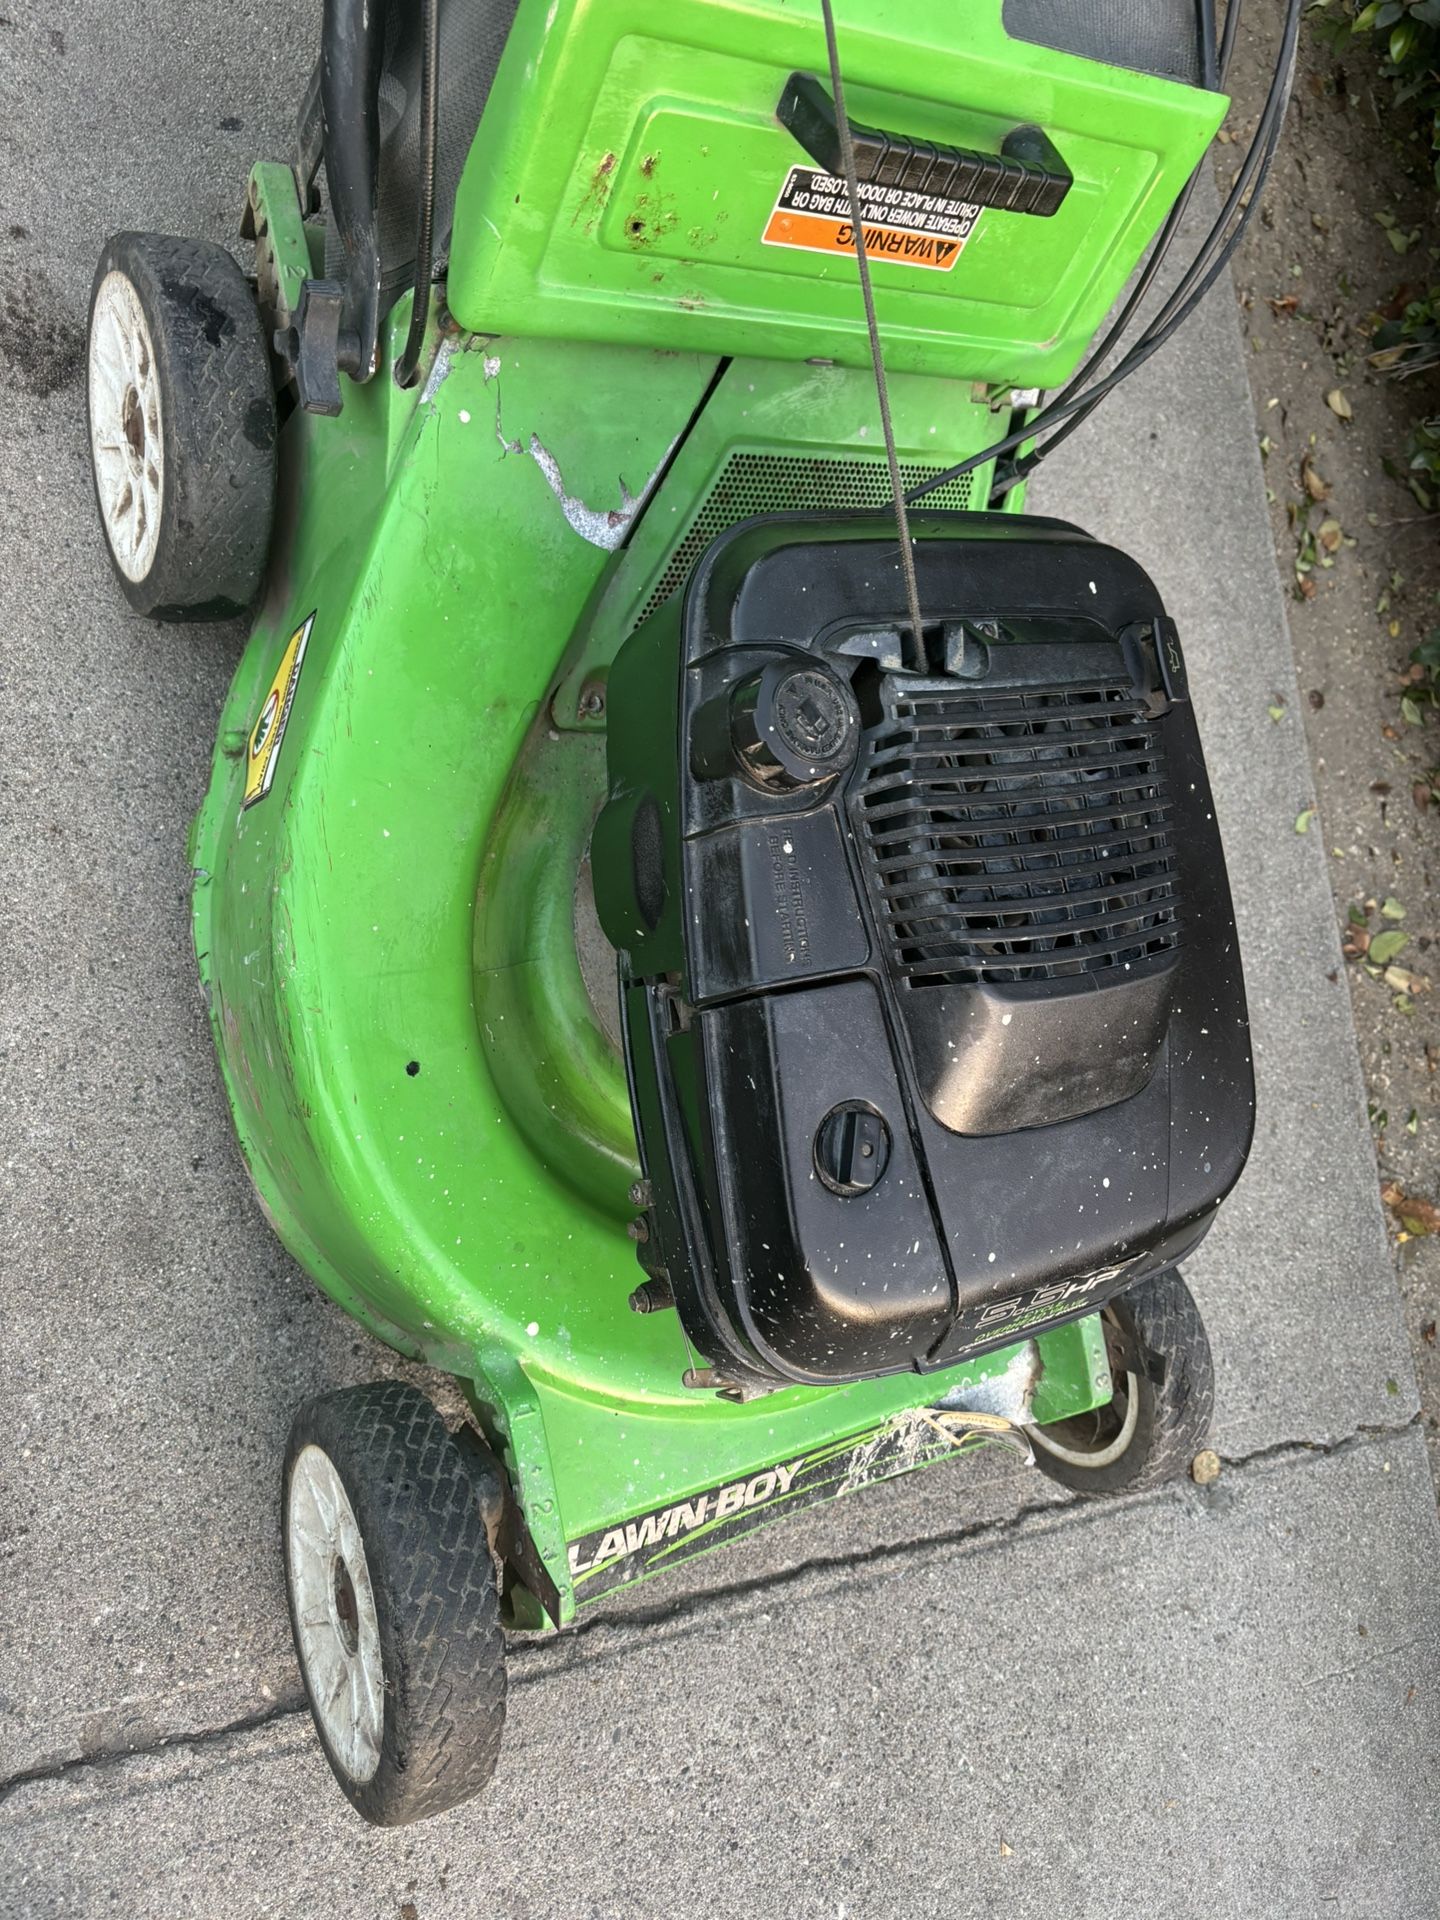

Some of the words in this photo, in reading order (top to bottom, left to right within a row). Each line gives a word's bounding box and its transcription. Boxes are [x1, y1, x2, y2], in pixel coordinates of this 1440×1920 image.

[791, 191, 810, 208] OR
[856, 183, 886, 201] DOOR
[888, 189, 903, 204] OR
[809, 194, 835, 212] BAG
[832, 198, 861, 215] ITH
[903, 192, 935, 211] PLACE
[936, 197, 948, 212] IN
[947, 200, 979, 217] CHUTE
[859, 203, 888, 220] ONLY
[887, 208, 927, 228] MOWER
[927, 214, 970, 235] OPERATE
[836, 224, 935, 258] WARNIG
[769, 834, 786, 892] BEFORE
[568, 1458, 806, 1575] LAWN-BOY
